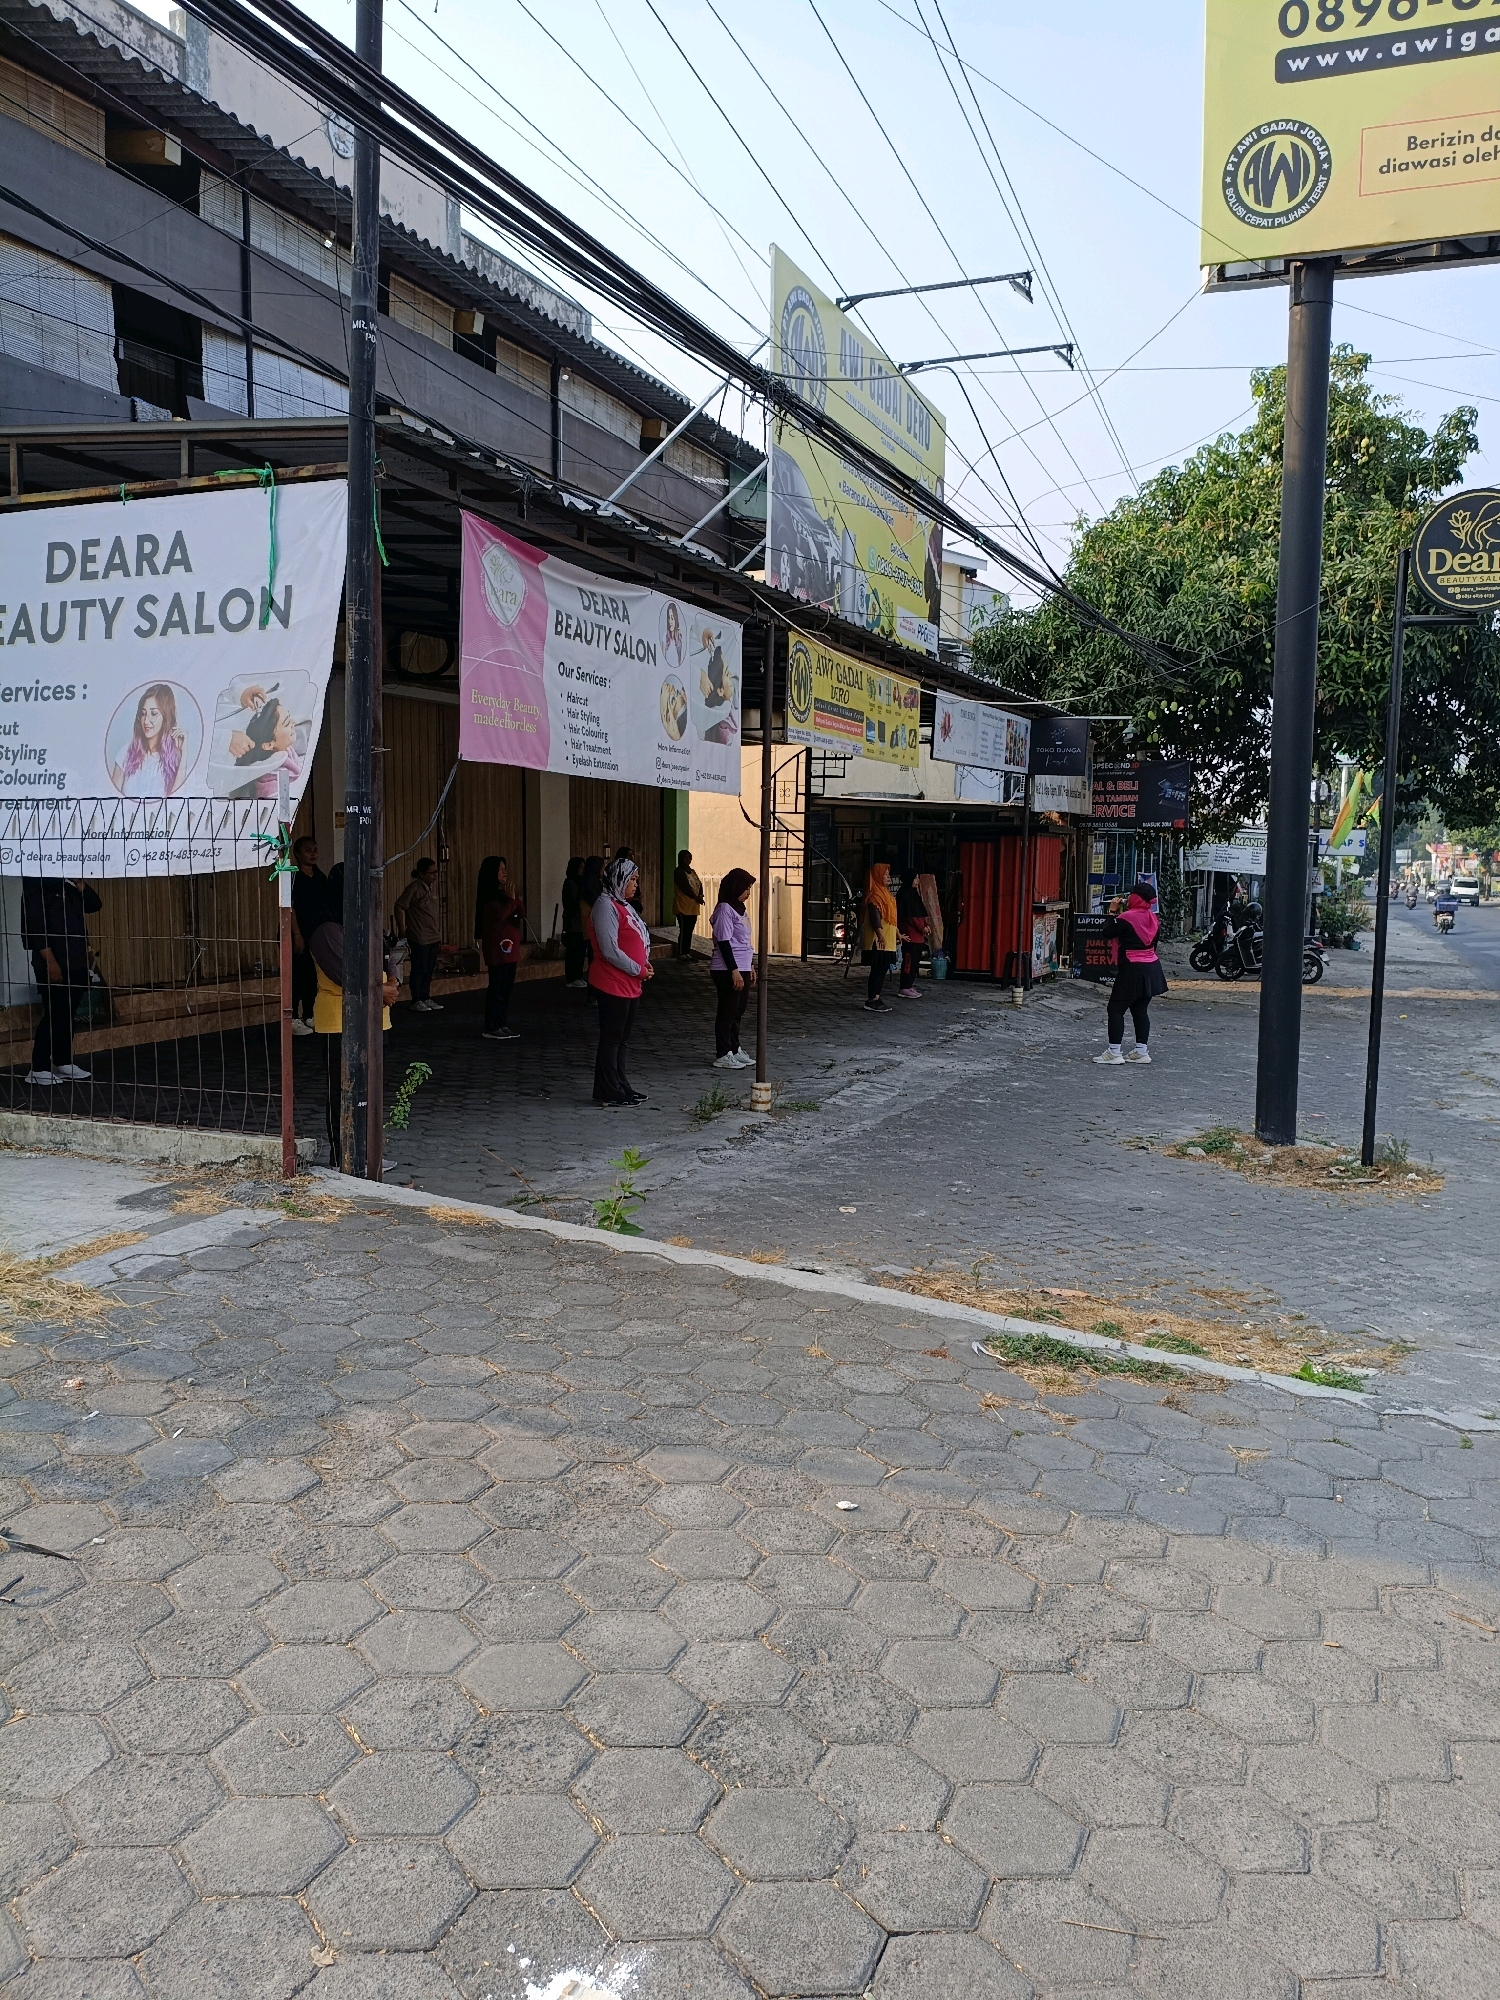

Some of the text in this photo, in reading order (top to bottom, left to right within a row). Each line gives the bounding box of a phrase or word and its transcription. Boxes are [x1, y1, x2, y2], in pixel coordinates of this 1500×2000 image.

[1278, 0, 1500, 38] 0896-
[1287, 26, 1500, 71] www.awiga
[1227, 122, 1329, 171] PT AWI GADAI JOGJA
[1407, 130, 1475, 151] Berizin
[1379, 145, 1500, 174] diawasi oleh
[1225, 175, 1328, 227] SOLUSI CEPAT PILIHAN TEPAT
[840, 327, 864, 392] AWI
[869, 357, 902, 427] GADAI
[906, 392, 931, 452] DERO
[46, 530, 193, 584] DEARA
[1440, 576, 1478, 584] BEAUTY
[133, 584, 293, 639] SALON
[577, 586, 631, 625] DEARA
[554, 609, 657, 667] BEAUTY SALON
[558, 661, 574, 679] Our
[575, 666, 608, 688] Services
[836, 662, 864, 691] GADAI
[0, 679, 76, 702] ervices
[567, 691, 589, 707] Haircut
[830, 685, 850, 705] DERO
[471, 689, 543, 721] Everyday Beauty,
[474, 709, 537, 734] made effortless
[567, 707, 601, 727] Hair Styling
[568, 723, 609, 743] Hair Colouring
[570, 738, 612, 756] Hair Treatment
[572, 754, 619, 772] Eyelash Extension
[1116, 780, 1139, 791] BELI
[1088, 805, 1136, 817] RVICE
[111, 828, 170, 839] Information
[27, 850, 111, 864] deara_beautysalon
[1085, 939, 1105, 948] JUAL
[1085, 955, 1117, 965] SERV
